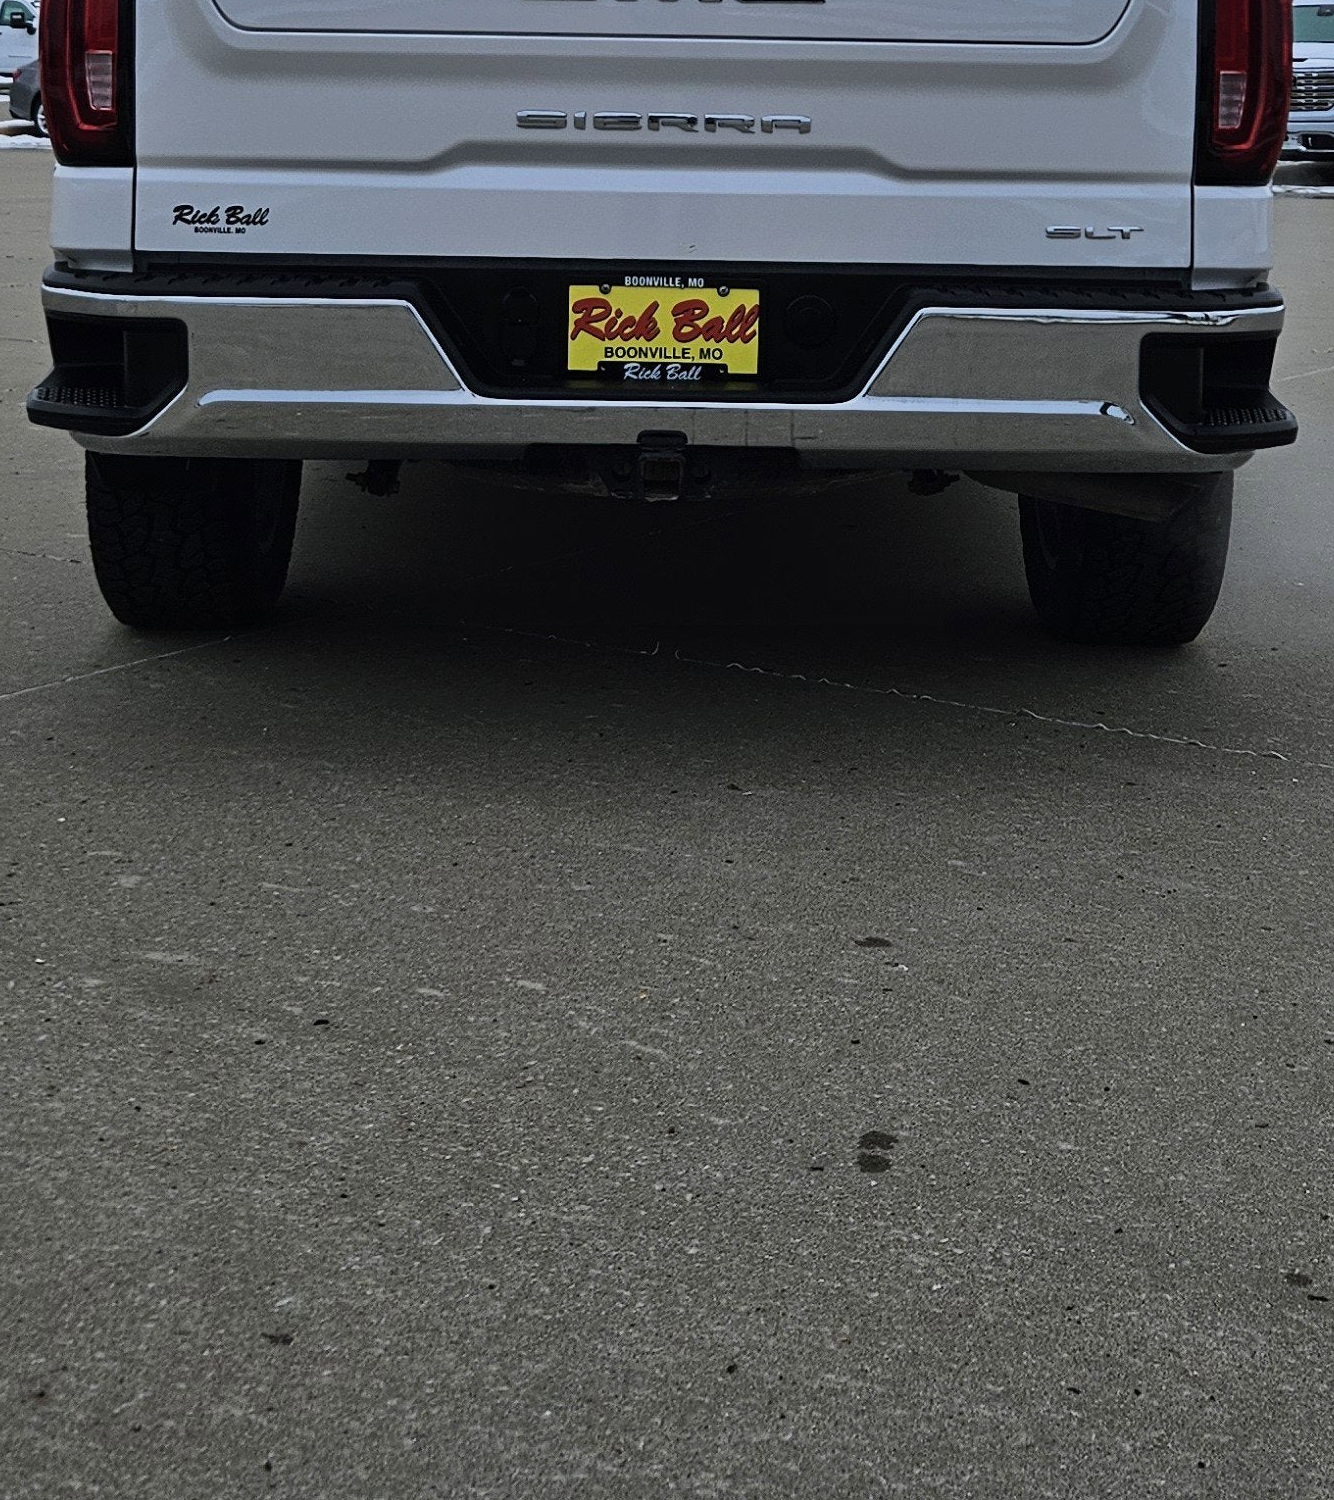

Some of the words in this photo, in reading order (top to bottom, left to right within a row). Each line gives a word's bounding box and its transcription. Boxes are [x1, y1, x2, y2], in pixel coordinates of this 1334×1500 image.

[516, 109, 812, 134] SIERRA
[172, 204, 220, 225] Rick
[224, 205, 270, 226] Ball
[1046, 226, 1144, 239] SLT
[624, 276, 685, 288] BOONVILLE,
[688, 277, 705, 288] MO
[570, 297, 661, 342] Rick
[671, 299, 760, 344] Ball
[604, 346, 695, 361] BOONVILLE,
[699, 347, 723, 360] MO
[623, 362, 662, 380] Rick
[666, 363, 702, 381] Ball
